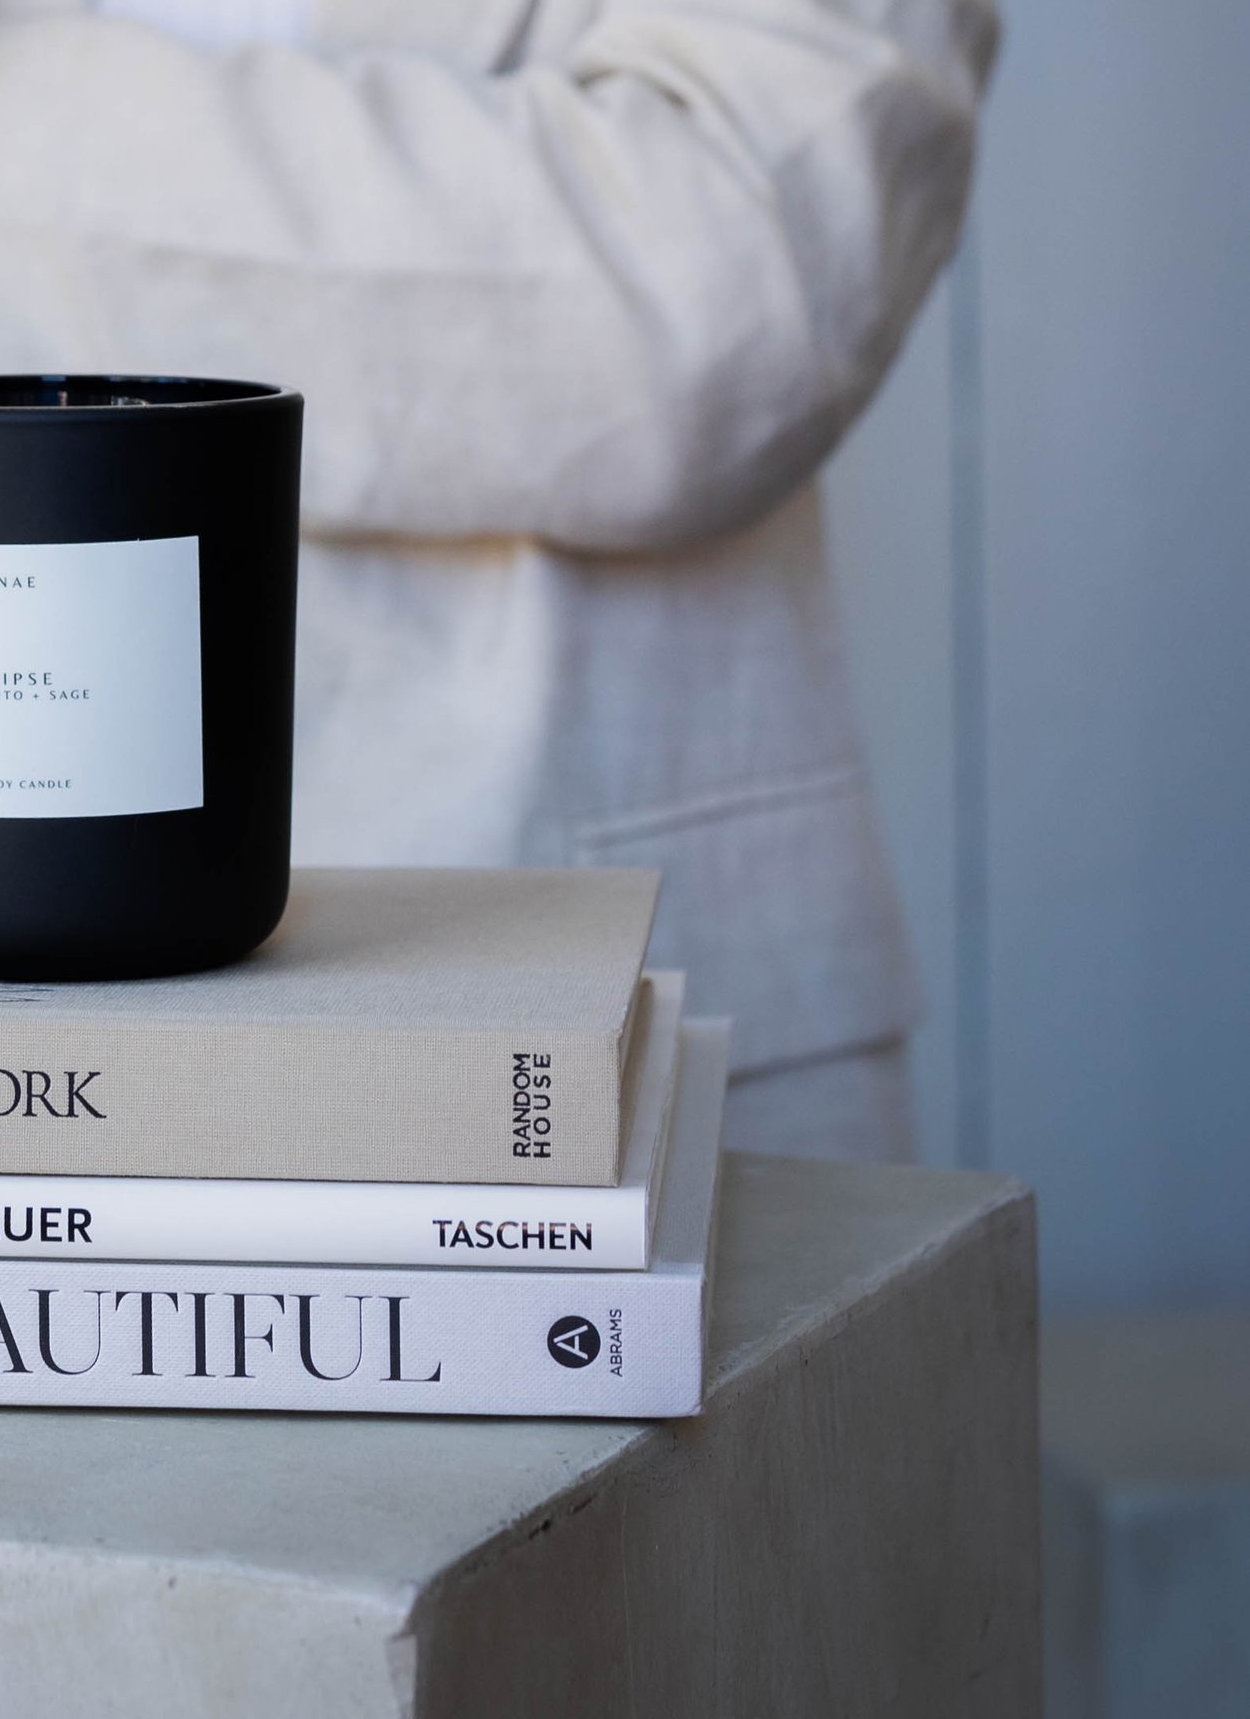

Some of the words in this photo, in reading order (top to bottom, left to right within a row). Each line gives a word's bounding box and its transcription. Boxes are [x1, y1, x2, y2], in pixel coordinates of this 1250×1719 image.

[49, 689, 91, 700] SAGE
[19, 779, 73, 789] CANDLE
[512, 1053, 531, 1158] RANDOM
[534, 1053, 552, 1159] HOUSE
[432, 1219, 593, 1251] TASCHEN
[609, 1308, 623, 1378] ABRAMS
